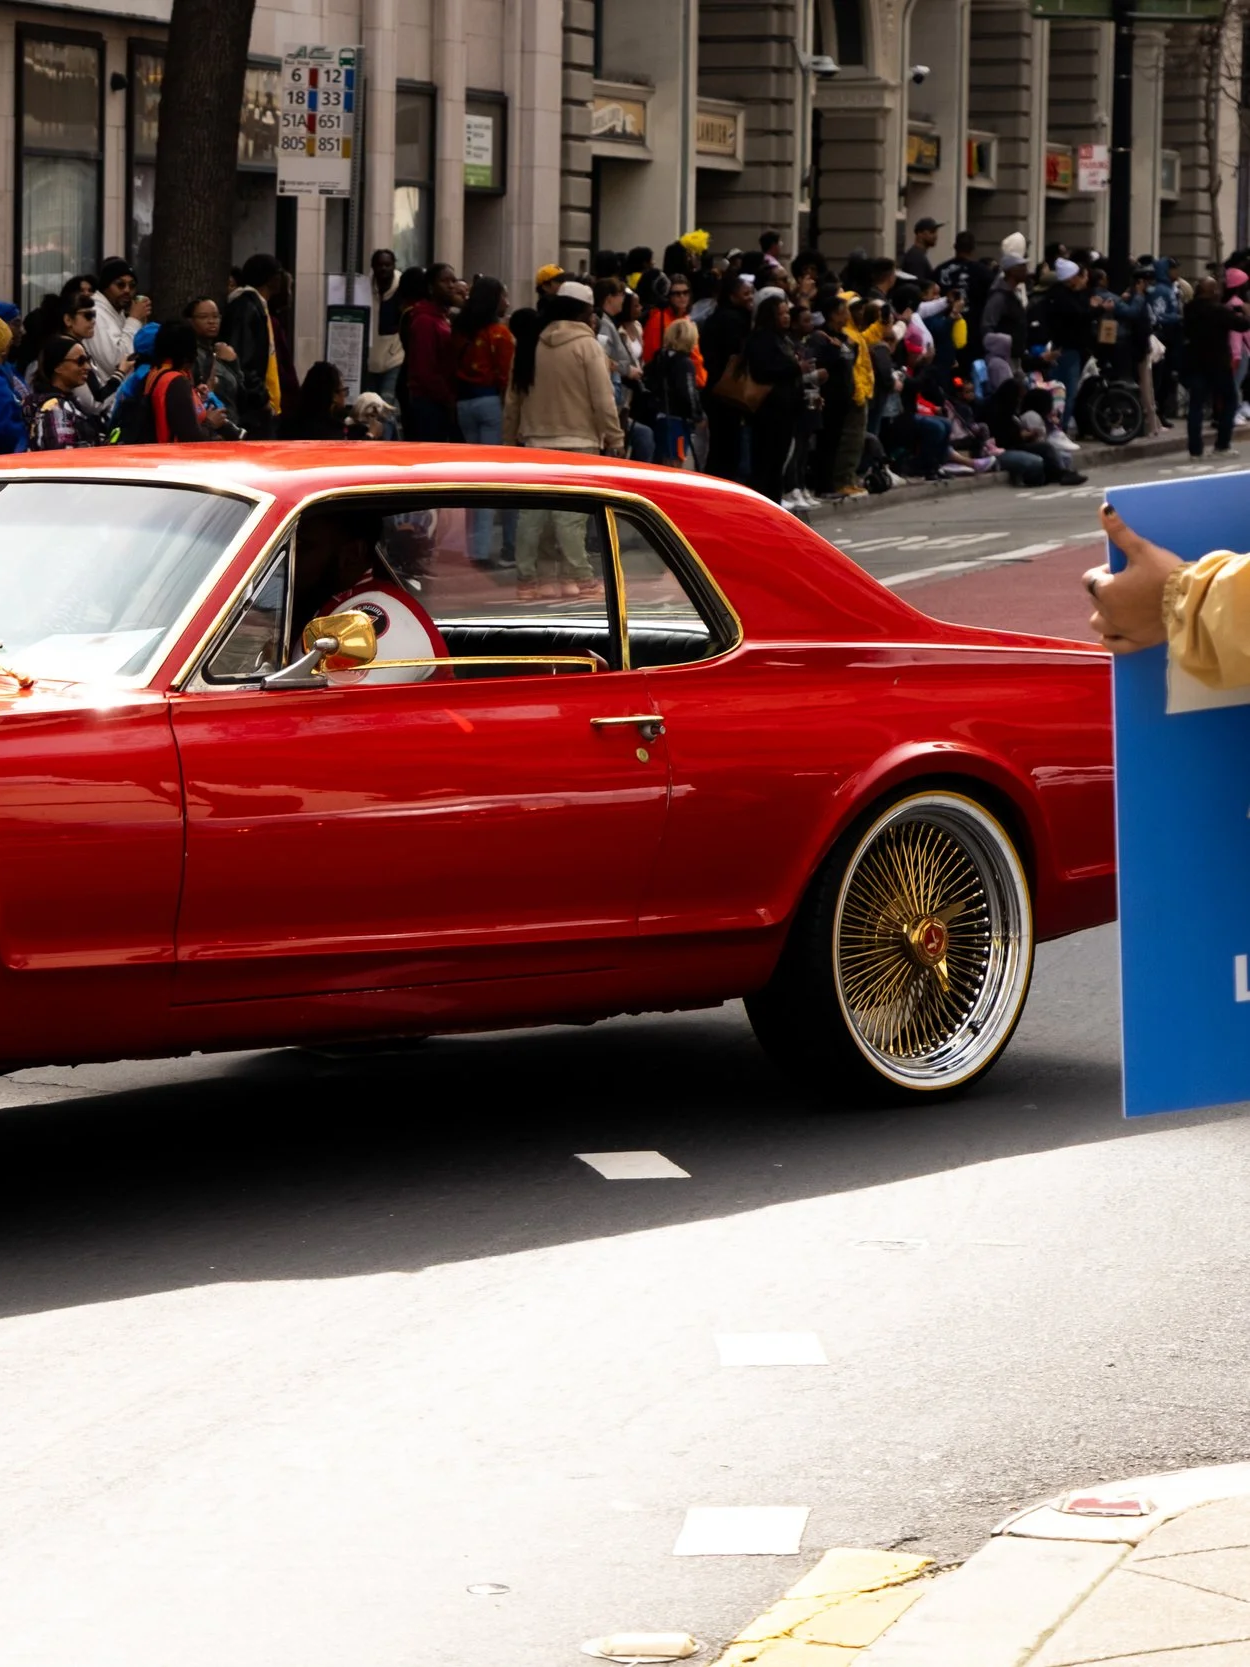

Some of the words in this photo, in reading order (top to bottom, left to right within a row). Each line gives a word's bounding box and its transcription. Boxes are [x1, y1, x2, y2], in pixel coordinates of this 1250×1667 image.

[291, 68, 302, 82] 6
[324, 69, 342, 83] 12
[287, 91, 305, 105] 18
[321, 92, 341, 106] 33
[282, 113, 308, 128] 51A
[318, 114, 341, 129] 651
[281, 136, 306, 150] 805
[318, 137, 340, 151] 851
